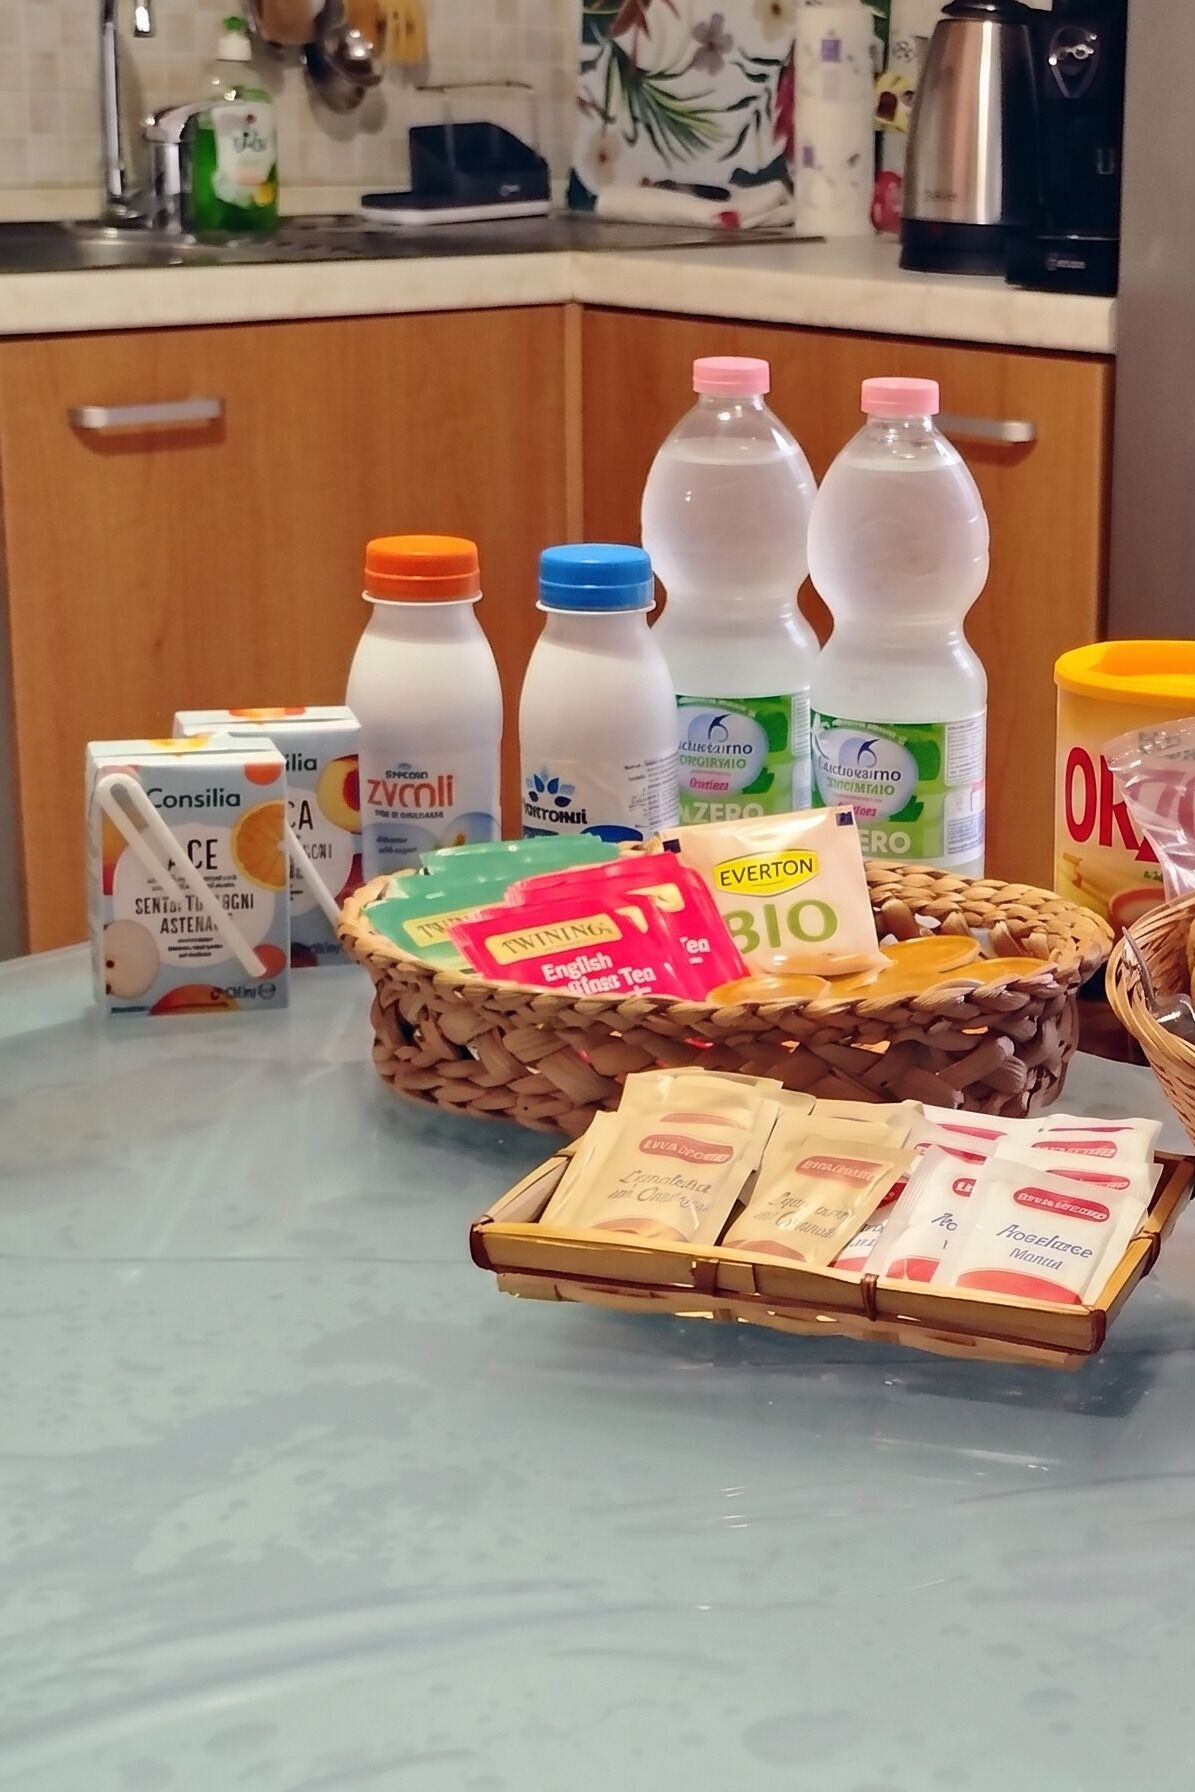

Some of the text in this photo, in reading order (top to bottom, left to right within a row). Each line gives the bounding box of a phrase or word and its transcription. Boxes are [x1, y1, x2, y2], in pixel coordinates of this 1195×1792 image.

[147, 787, 241, 809] Consilia
[860, 830, 912, 854] ERO
[719, 857, 814, 887] EVERTON
[722, 899, 838, 955] BIO
[617, 966, 657, 985] Tea
